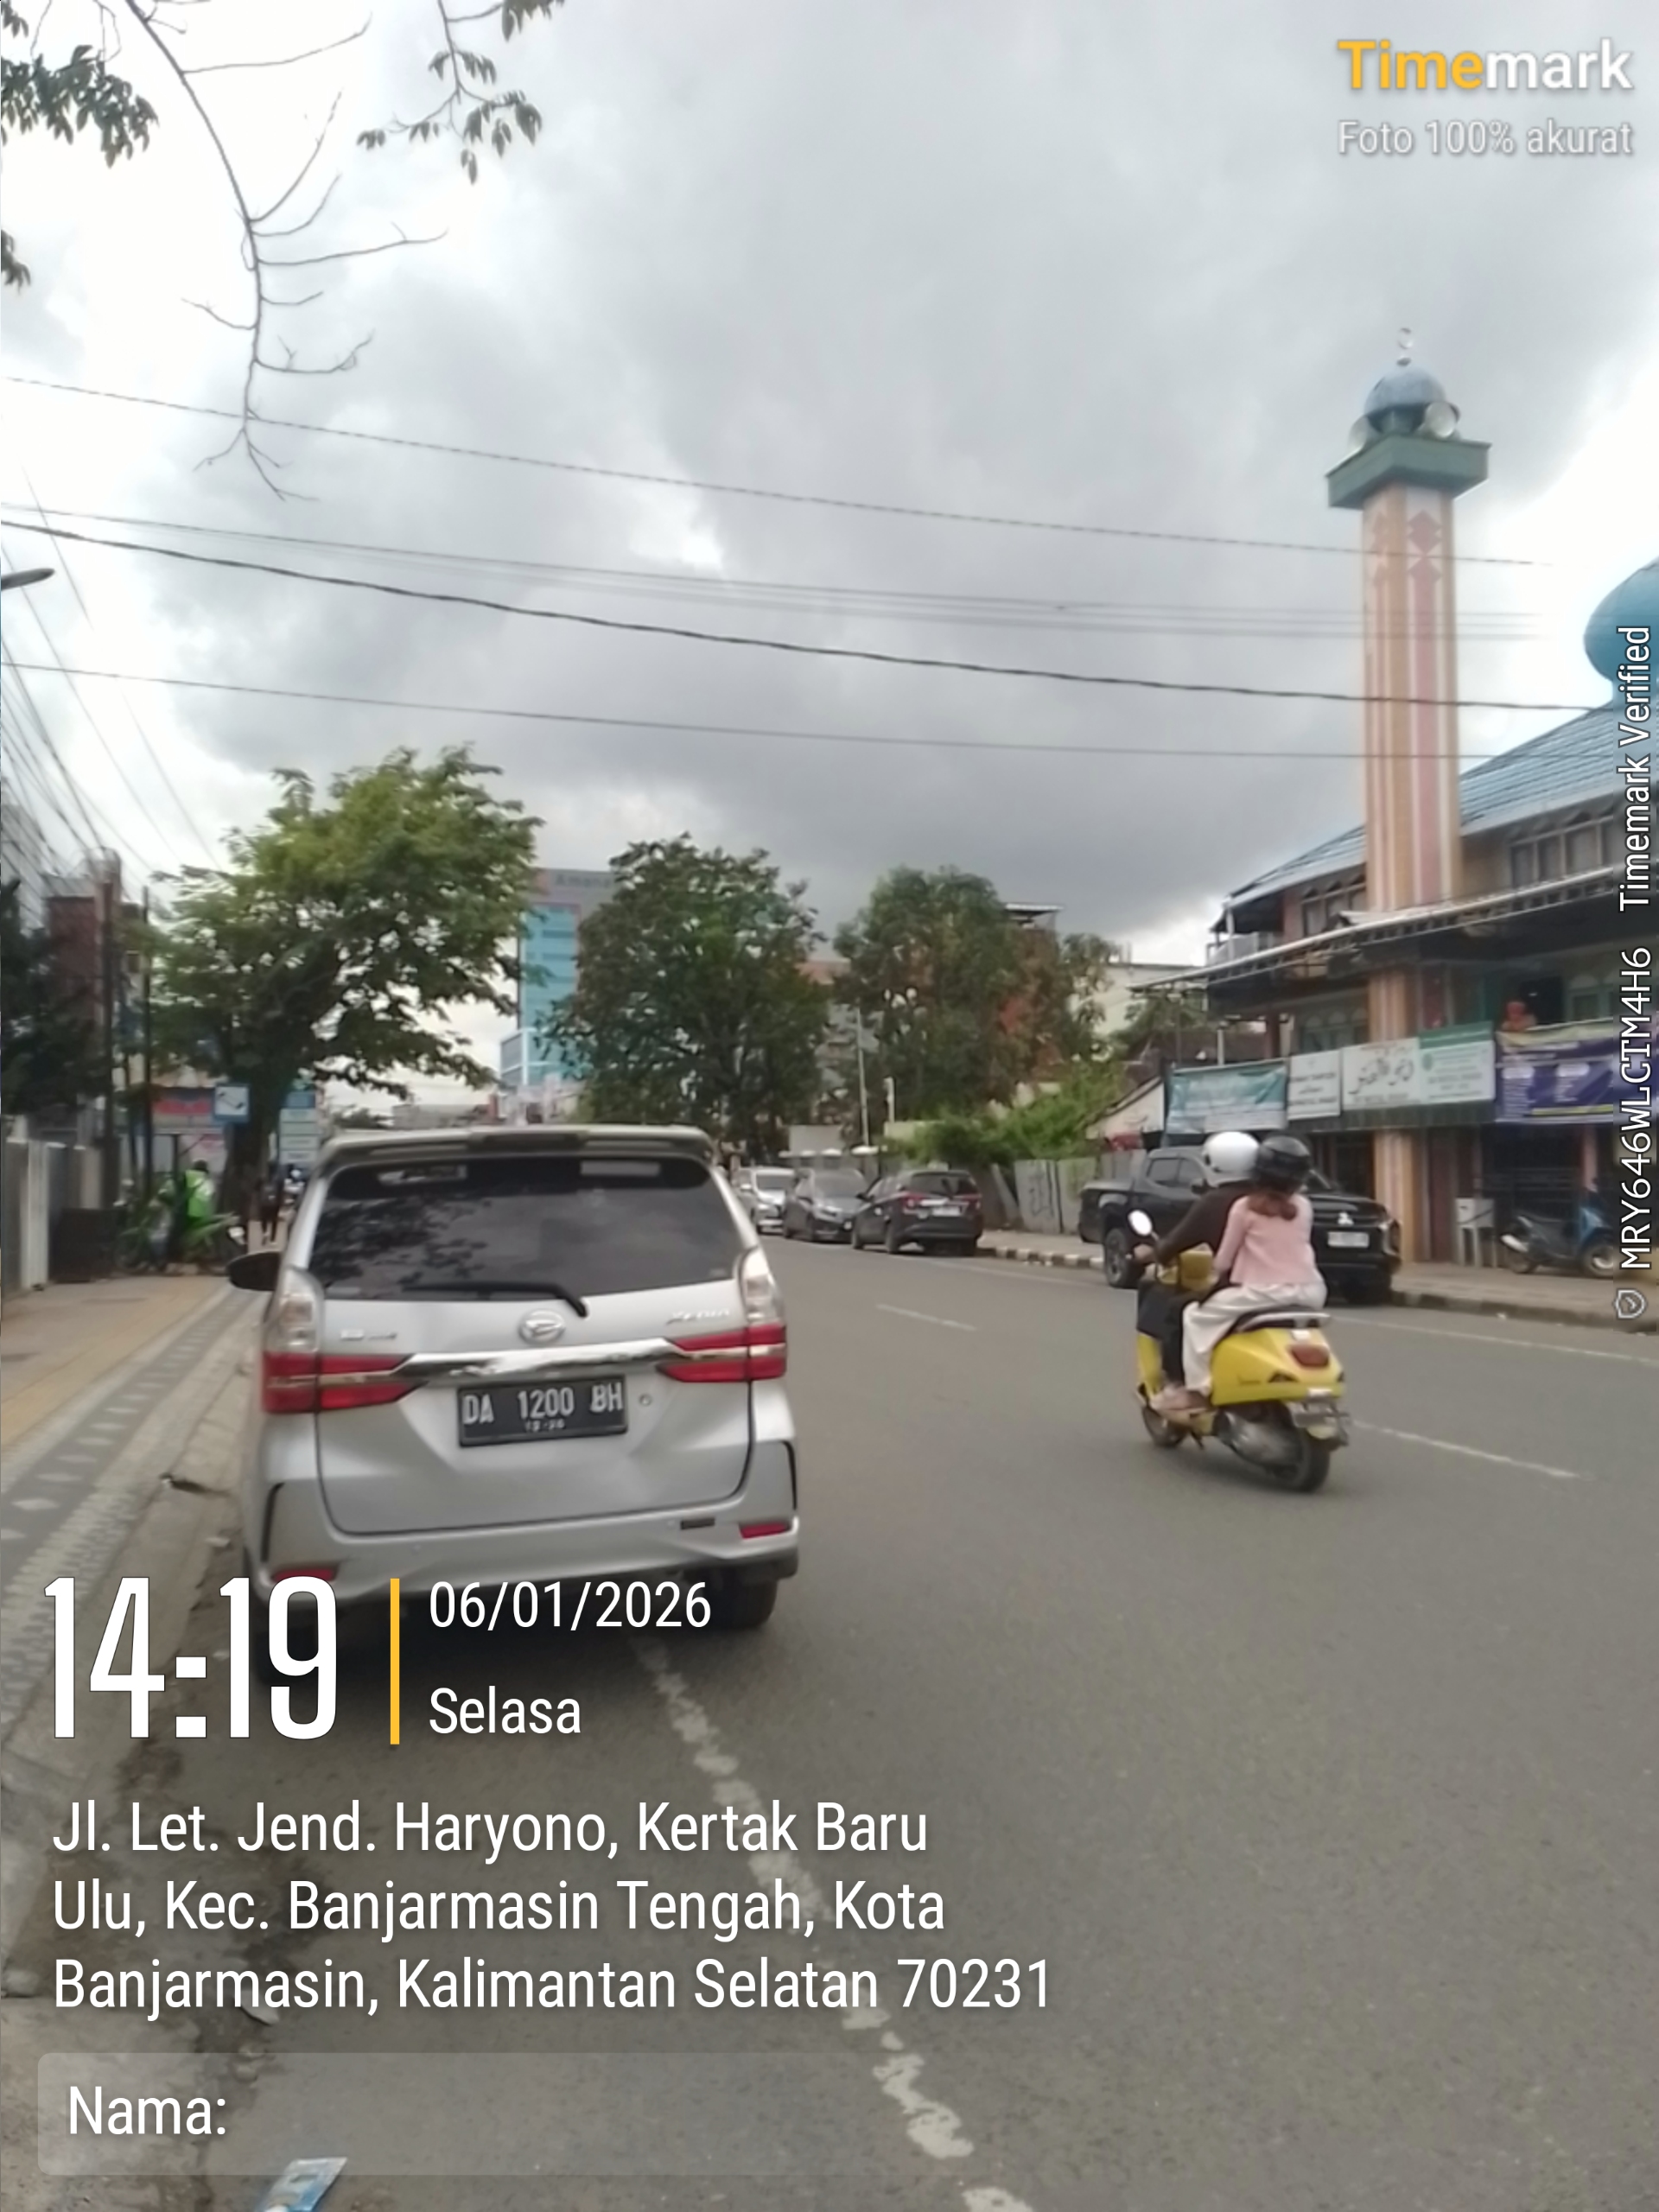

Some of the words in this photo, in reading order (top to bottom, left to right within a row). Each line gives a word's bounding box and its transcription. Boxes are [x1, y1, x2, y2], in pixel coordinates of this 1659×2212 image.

[462, 1394, 494, 1424] DA
[518, 1387, 575, 1420] 1200
[590, 1382, 623, 1413] BH
